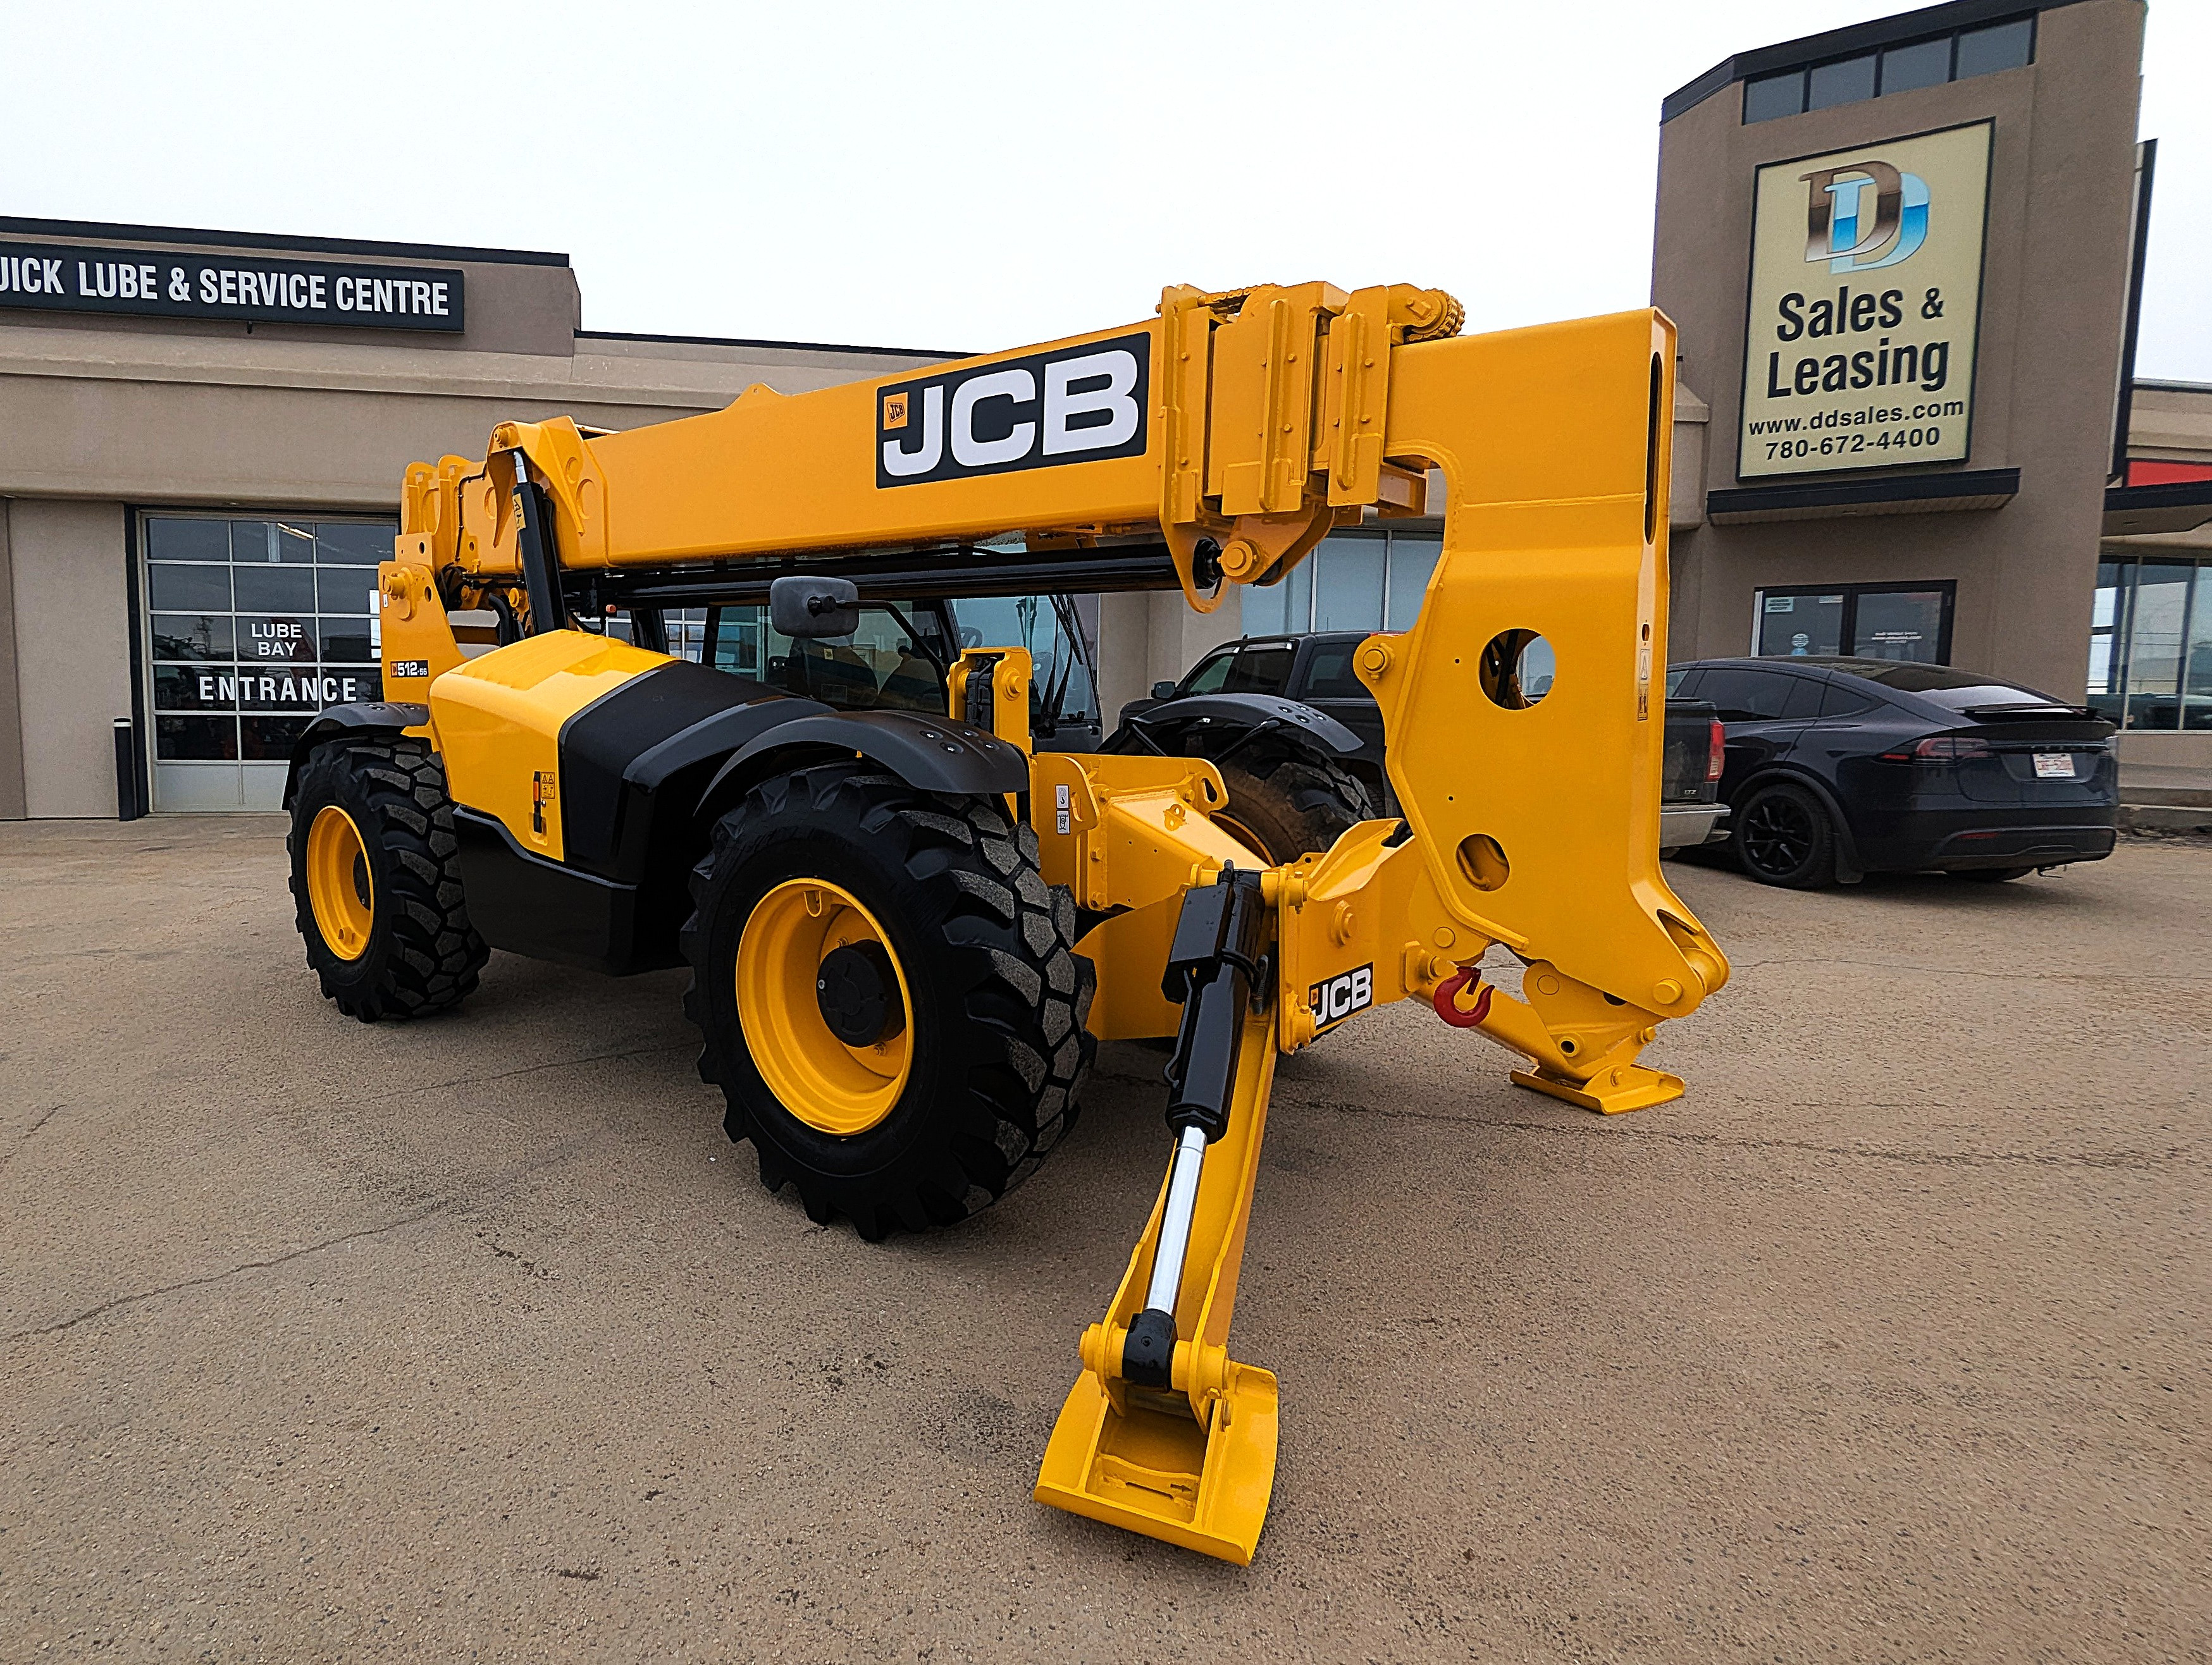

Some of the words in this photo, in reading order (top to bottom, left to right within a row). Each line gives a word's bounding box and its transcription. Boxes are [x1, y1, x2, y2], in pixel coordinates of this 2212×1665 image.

[78, 261, 157, 299] LUBE
[168, 267, 191, 302] &
[199, 269, 326, 309] SERVICE
[335, 276, 449, 315] CENTRE
[1777, 286, 1903, 341] Sales
[1920, 287, 1944, 319] &
[1767, 337, 1949, 398] Leasing
[884, 350, 1139, 476] JCB
[889, 404, 904, 420] JCB
[1749, 400, 1963, 435] www.ddsales.com
[1765, 427, 1940, 460] 780-672-4400
[251, 624, 302, 638] LUBE
[258, 642, 297, 656] BAY
[199, 676, 357, 701] ENTRANCE
[1312, 968, 1371, 1026] JCB
